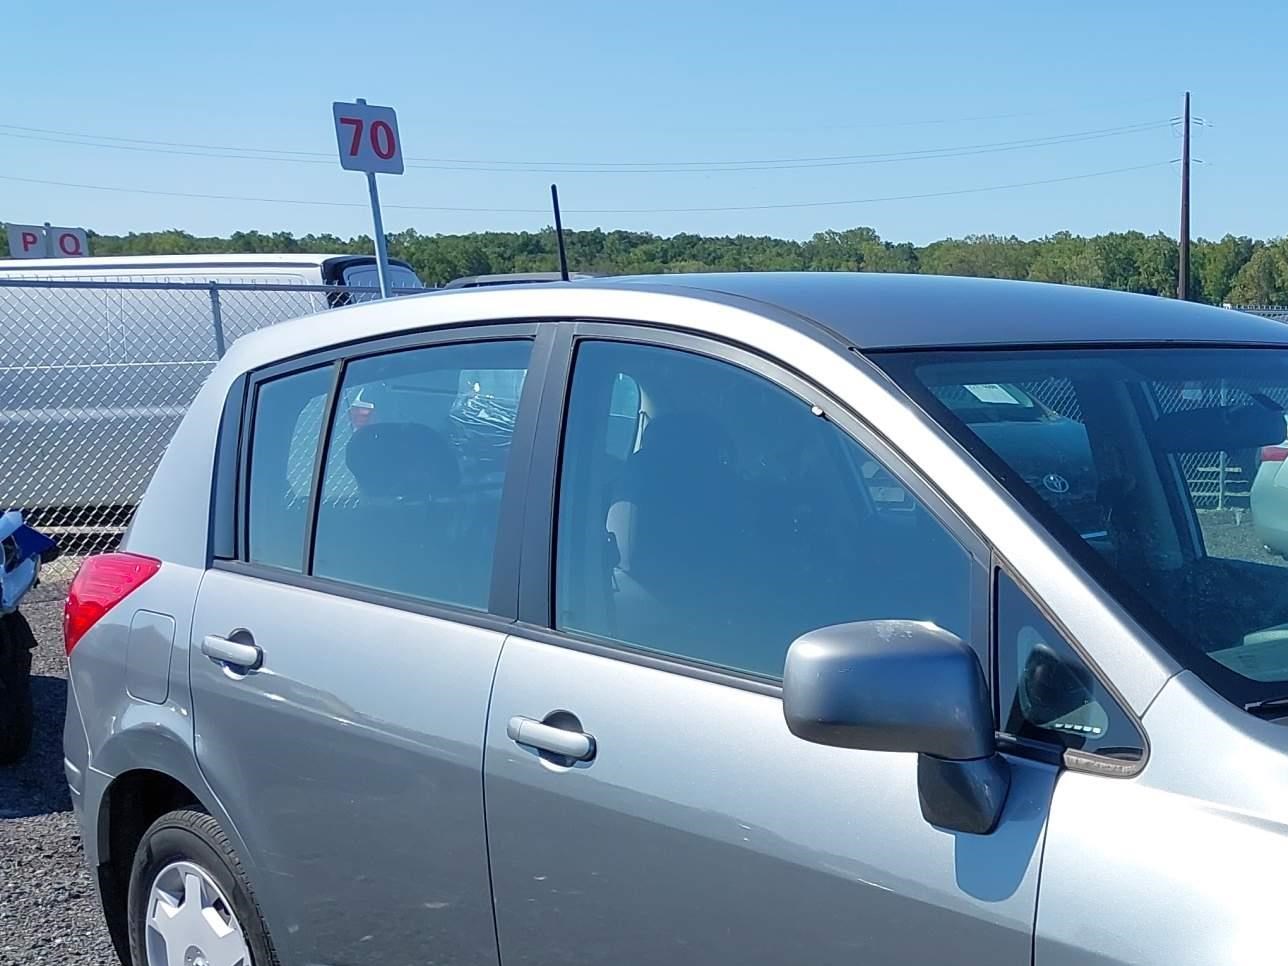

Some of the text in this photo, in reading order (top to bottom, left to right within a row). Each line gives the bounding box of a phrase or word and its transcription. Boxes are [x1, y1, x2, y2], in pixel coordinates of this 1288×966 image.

[339, 117, 396, 160] 70
[22, 232, 38, 252] P
[59, 233, 83, 256] Q
